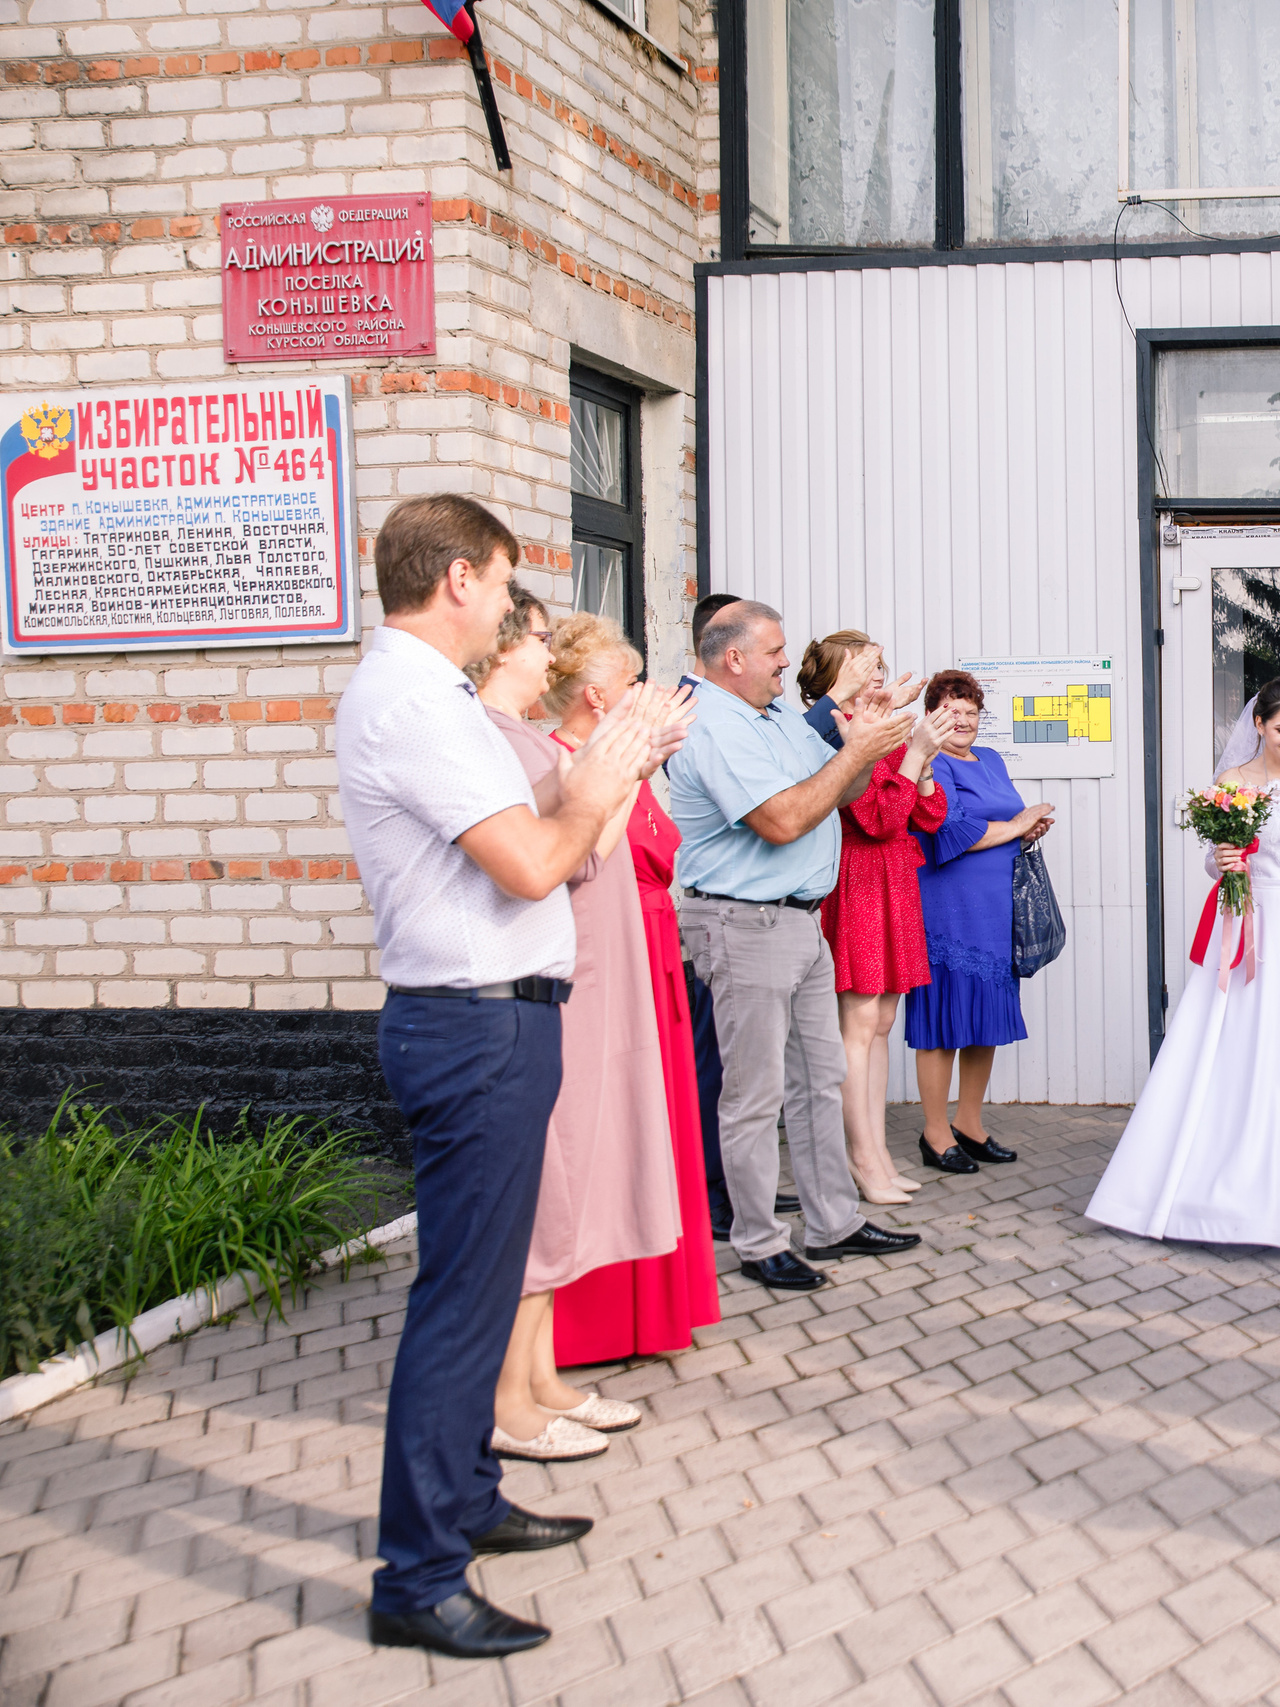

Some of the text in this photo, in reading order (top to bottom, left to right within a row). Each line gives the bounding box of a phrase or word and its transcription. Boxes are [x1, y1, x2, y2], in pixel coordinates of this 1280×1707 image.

[228, 208, 409, 229] РОССИЙСКАЯ ФЕДЕРАЦИЯ
[225, 237, 425, 271] АДМИНИСТРАЦИЯ
[285, 274, 364, 291] ПОСЕЛКА
[258, 294, 393, 317] КОНЫШЕВКА
[249, 318, 405, 336] КОНЫШЕВСКОГО РАЙОНА
[267, 334, 389, 349] КУРСКОЙ ОБЛАСТИ
[77, 385, 324, 450] ИЗБИРАТЕЛЬНЫЙ
